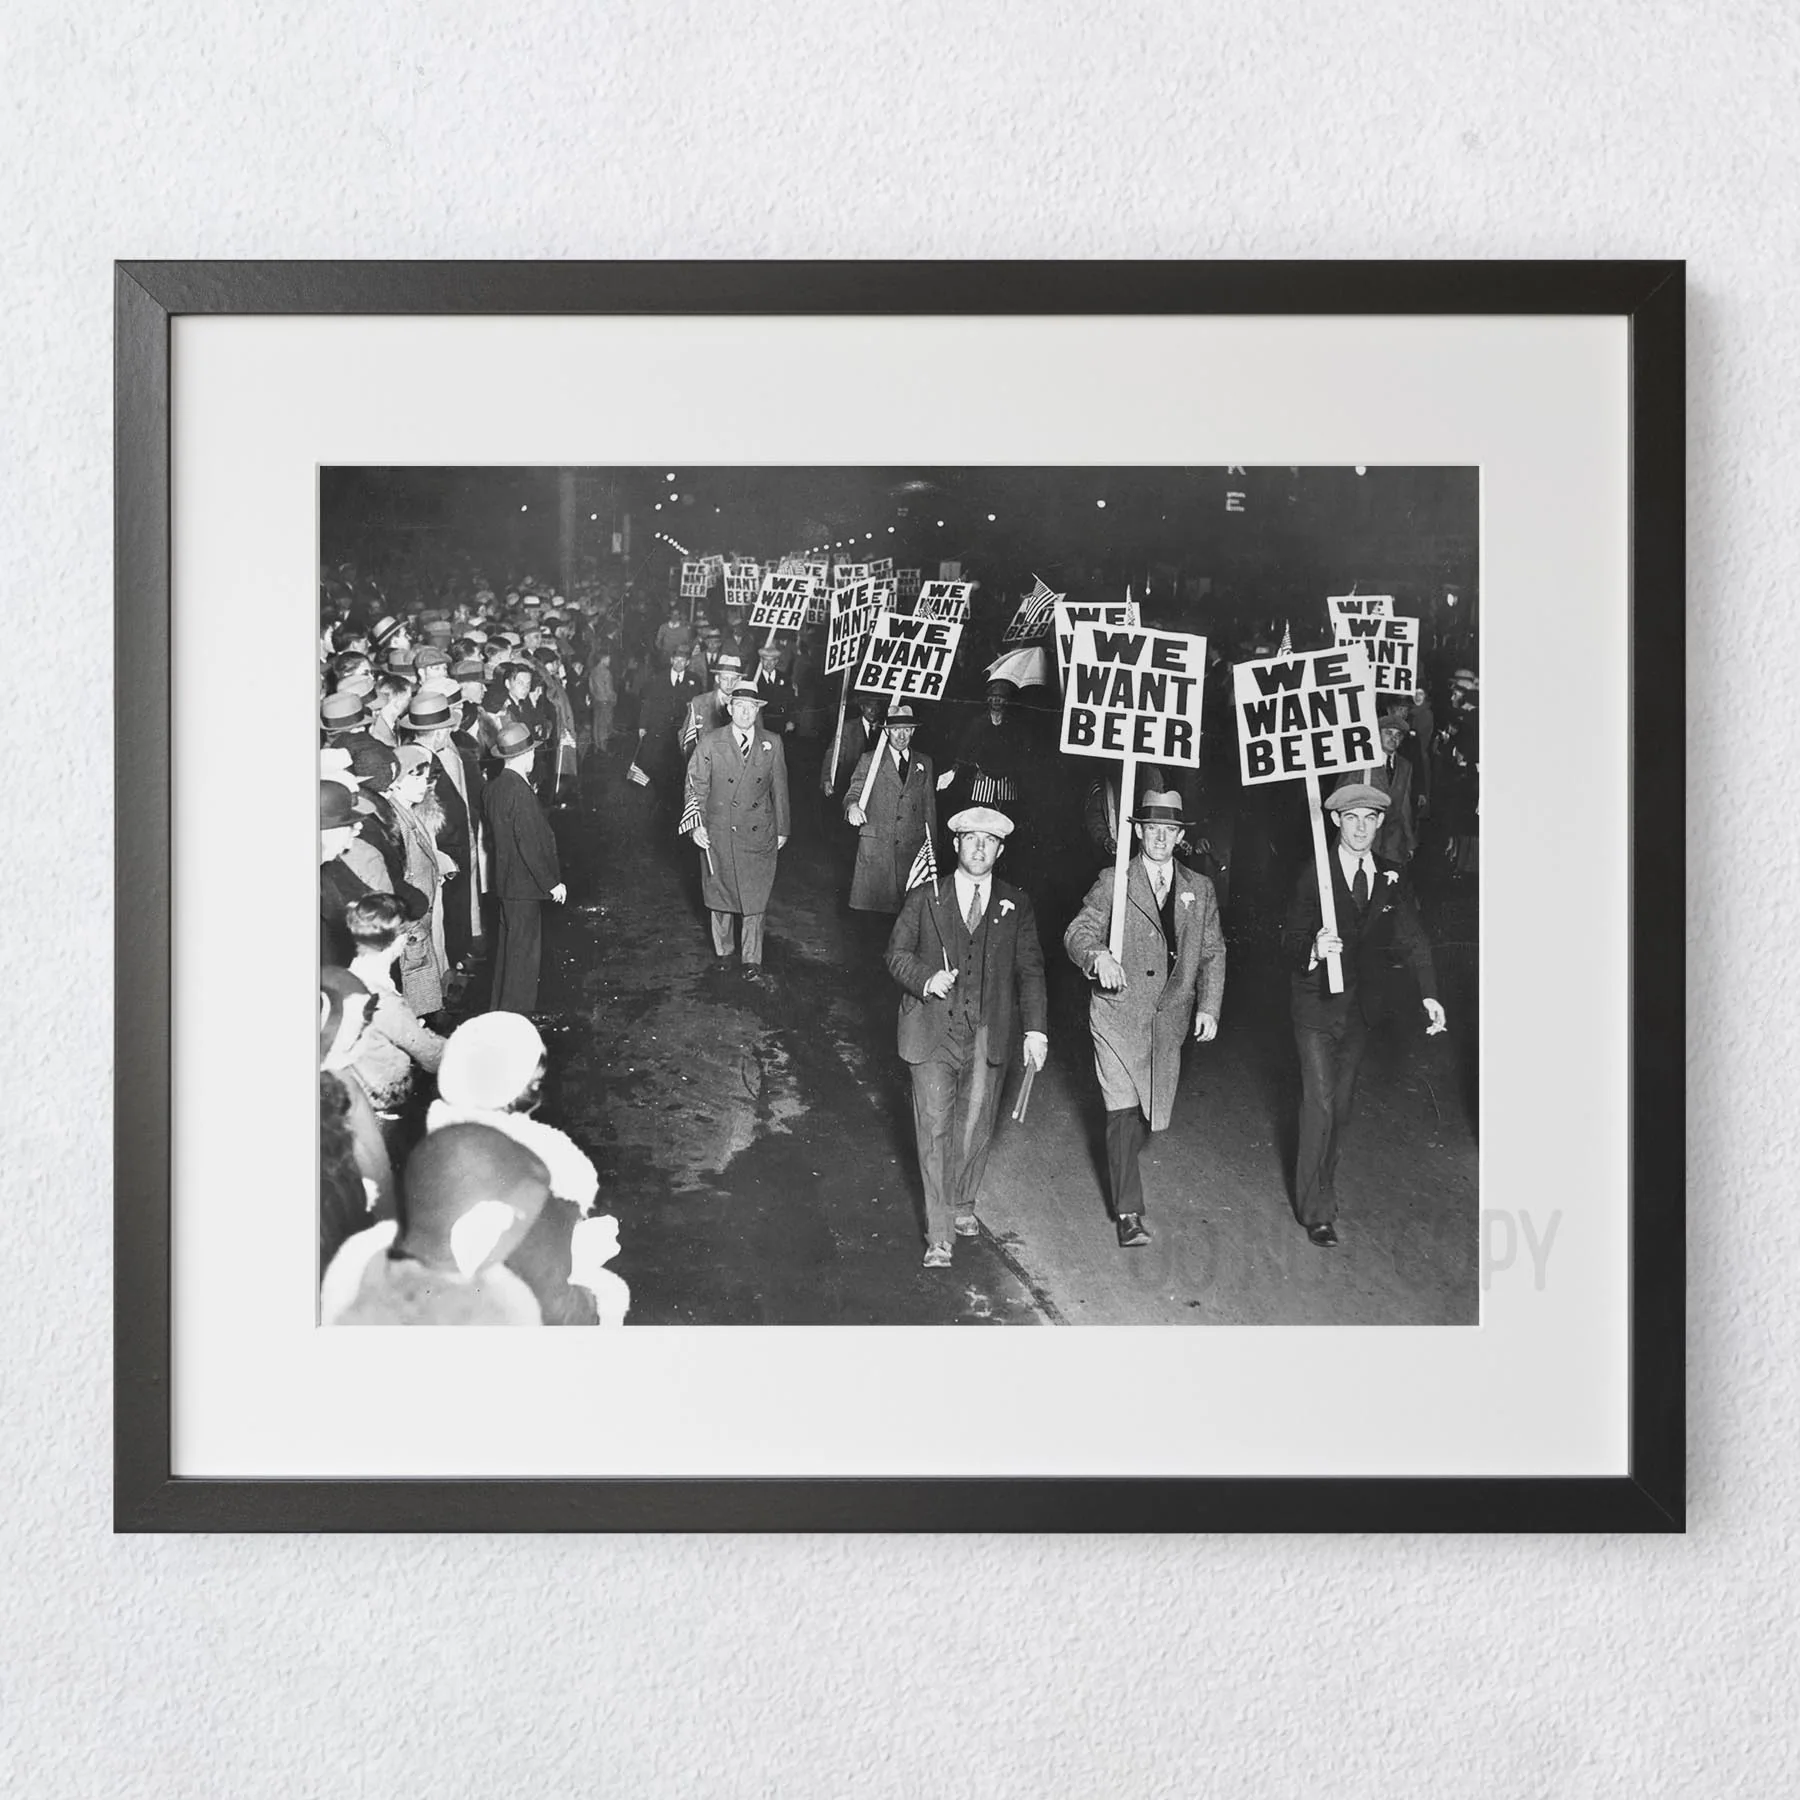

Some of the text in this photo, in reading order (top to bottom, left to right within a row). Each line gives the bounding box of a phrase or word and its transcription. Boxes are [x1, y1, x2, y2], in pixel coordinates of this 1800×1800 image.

[727, 577, 757, 590] WANT
[772, 576, 808, 593] WE
[840, 566, 864, 577] WE
[761, 590, 809, 610] WANT
[837, 583, 868, 613] WE
[929, 584, 965, 598] WE
[753, 608, 802, 626] BEER
[833, 605, 870, 642] WANT
[889, 617, 951, 646] WE
[1004, 622, 1049, 639] BEER
[1065, 607, 1126, 632] WE
[1348, 618, 1408, 640] WE
[872, 638, 957, 672] WANT
[1093, 629, 1189, 673] WE
[1339, 638, 1414, 666] ANT
[860, 663, 943, 696] BEER
[1077, 663, 1197, 716] WANT
[1252, 653, 1352, 697] WE
[1243, 684, 1365, 738] WANT
[1068, 707, 1193, 760] BEER
[1246, 726, 1375, 779] BEER
